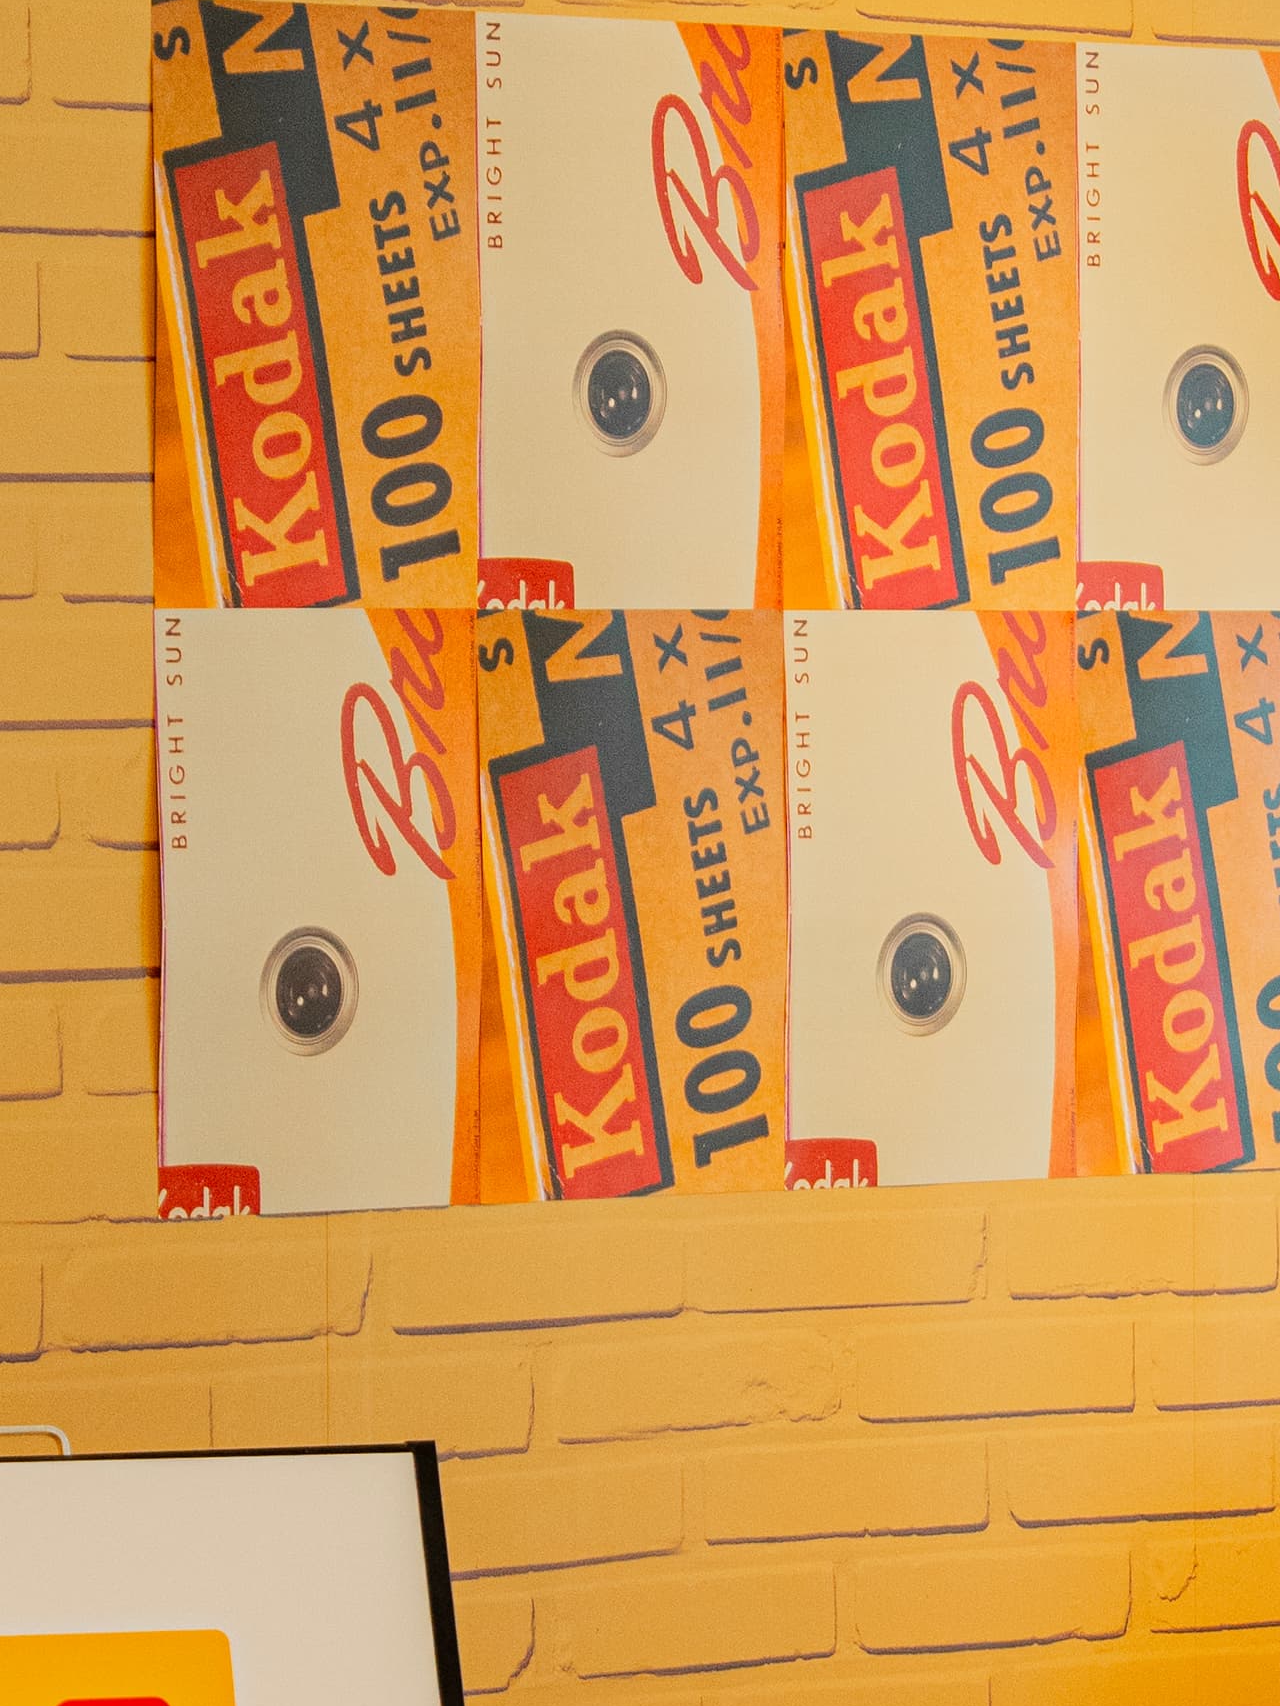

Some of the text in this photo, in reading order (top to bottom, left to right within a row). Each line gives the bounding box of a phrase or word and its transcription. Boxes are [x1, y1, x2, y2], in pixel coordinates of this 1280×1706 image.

[334, 101, 382, 151] 4
[485, 21, 503, 248] BRIGHT SUN
[949, 128, 992, 175] 4
[1085, 52, 1101, 267] BRIGHT SUN
[194, 169, 329, 586] Kodak
[370, 191, 432, 377] SHEETS
[979, 214, 1035, 390] SHEETS
[821, 193, 941, 588] Kodak
[361, 393, 460, 581] 100
[970, 407, 1060, 586] 100
[165, 618, 187, 849] BRIGHT SUN
[652, 700, 698, 750] 4
[793, 618, 813, 839] BRIGHT SUN
[1235, 697, 1277, 745] 4
[683, 787, 742, 968] SHEETS
[1114, 767, 1228, 1152] Kodak
[522, 774, 644, 1178] Kodak
[675, 984, 769, 1168] 100
